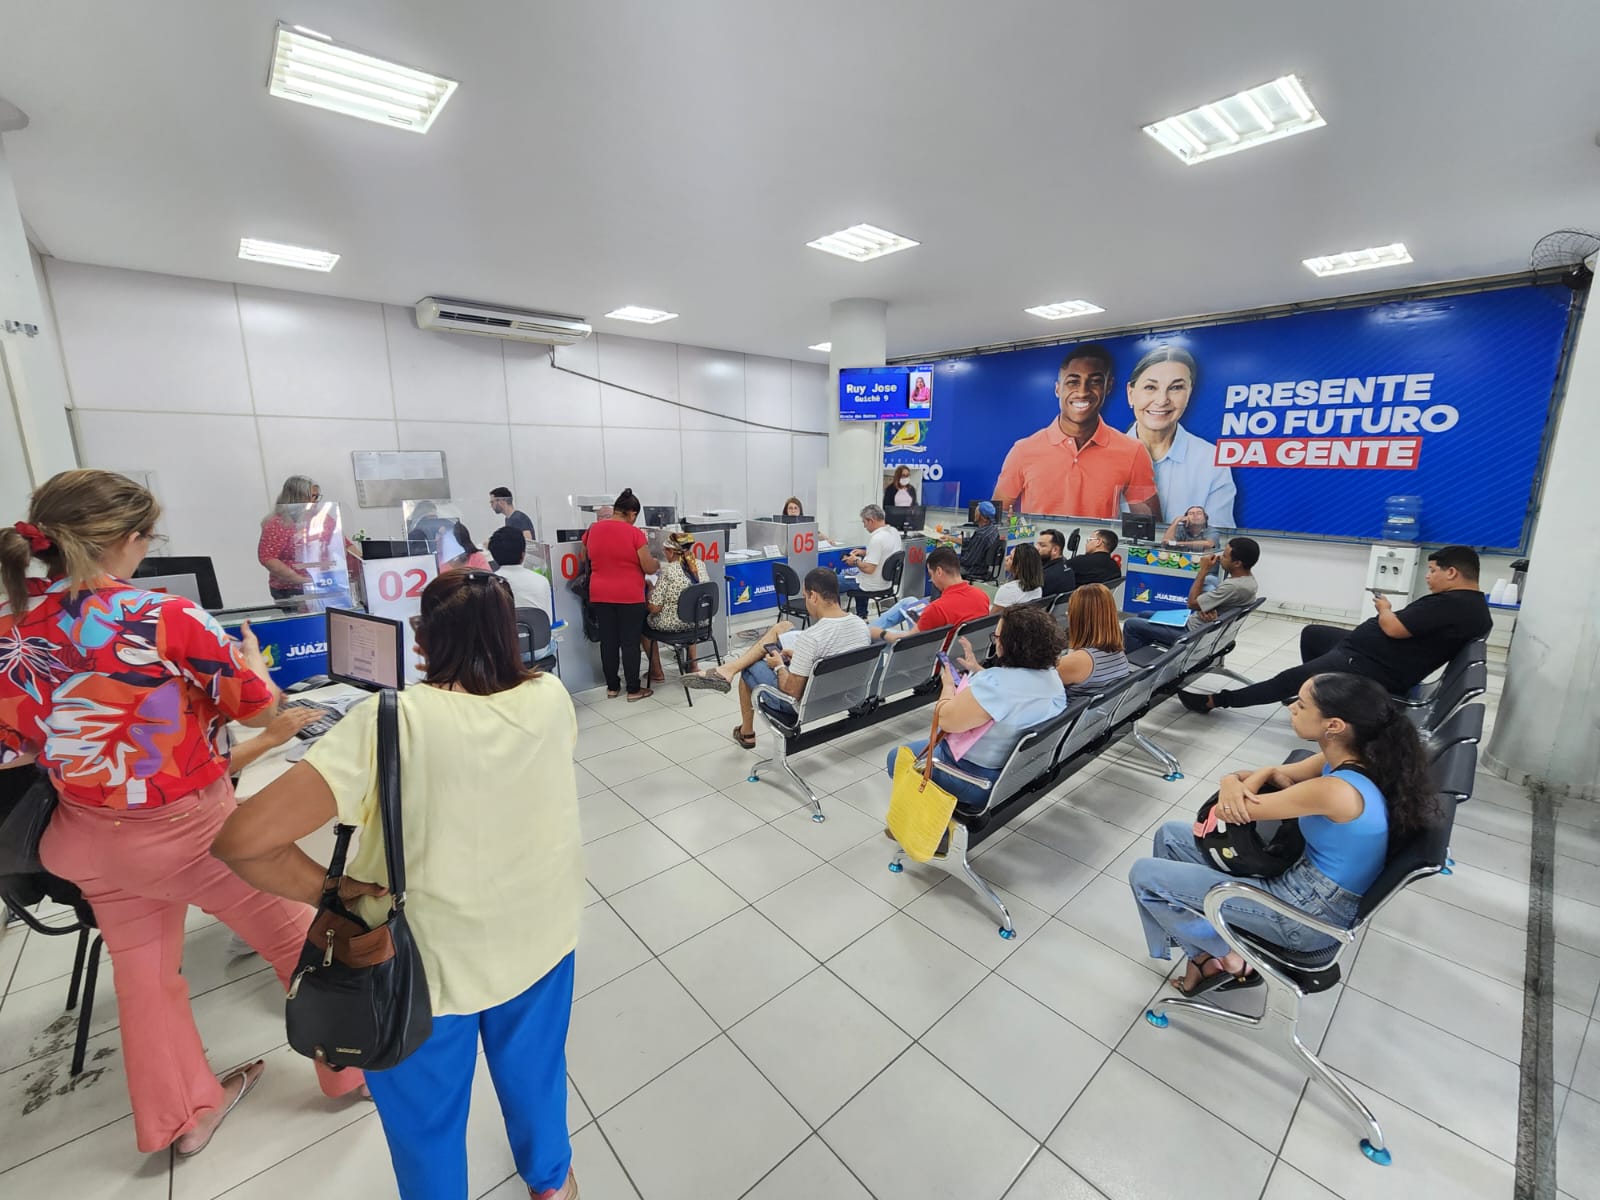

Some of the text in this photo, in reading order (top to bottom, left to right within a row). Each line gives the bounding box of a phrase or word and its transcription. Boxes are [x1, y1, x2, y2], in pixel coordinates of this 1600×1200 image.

[846, 383, 898, 396] Ruy Jose
[883, 394, 889, 402] 9
[1225, 373, 1435, 409] PRESENTE
[1221, 404, 1460, 436] NO FUTURO
[1217, 440, 1417, 467] DA GENTE
[692, 540, 720, 564] 04
[793, 532, 815, 554] 05
[561, 552, 584, 580] 0
[378, 568, 428, 602] 02
[286, 642, 328, 657] JUAZ
